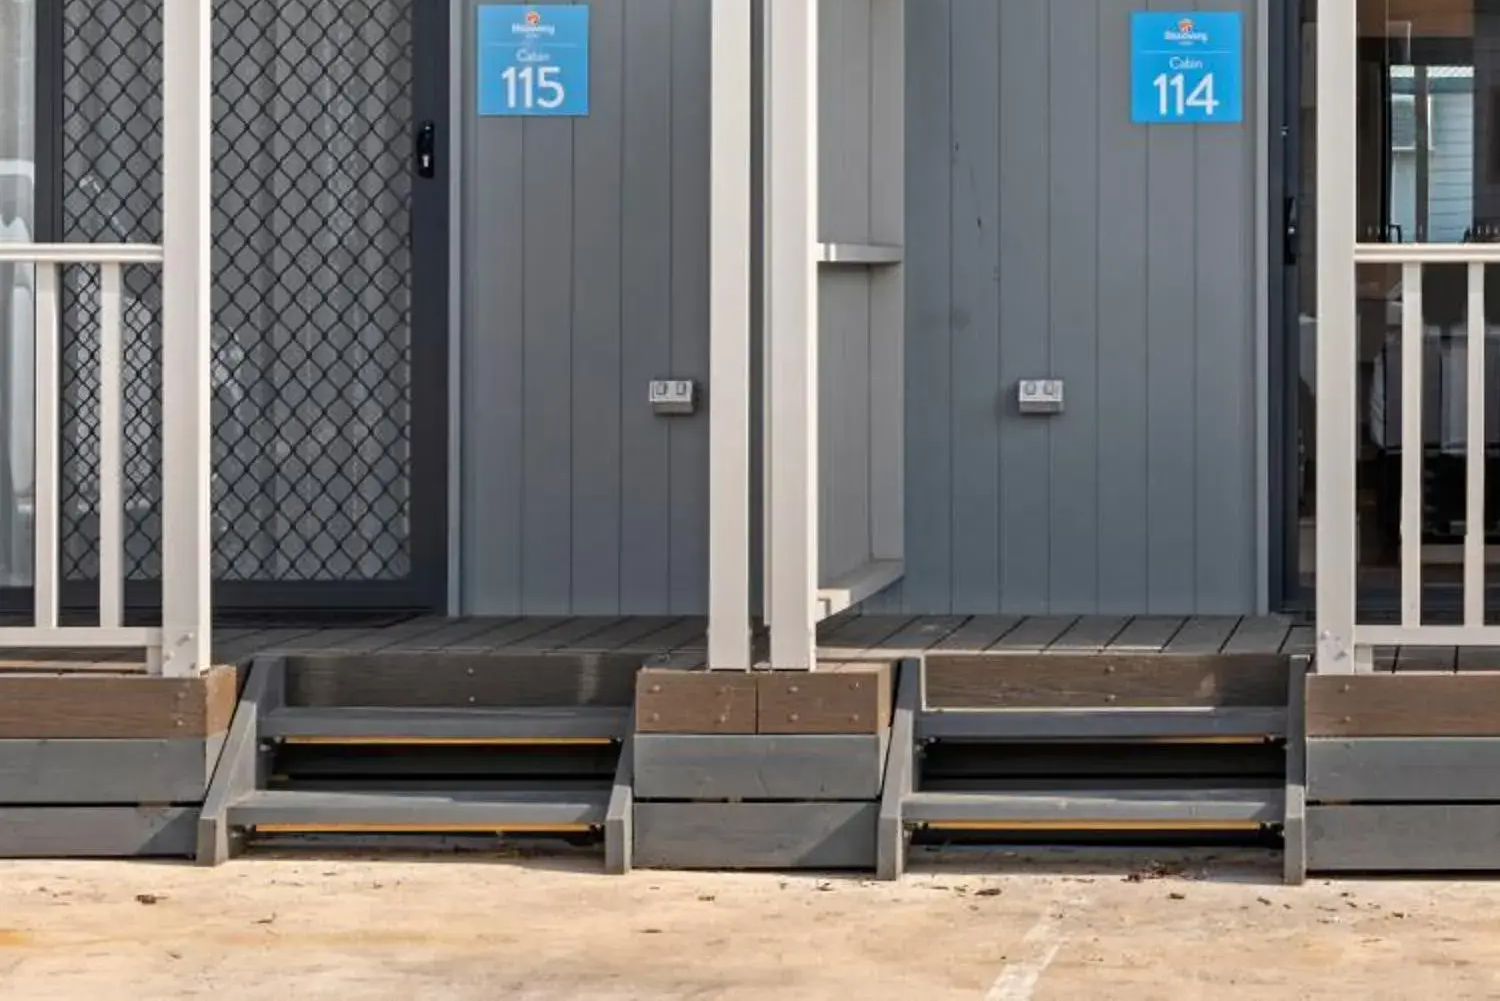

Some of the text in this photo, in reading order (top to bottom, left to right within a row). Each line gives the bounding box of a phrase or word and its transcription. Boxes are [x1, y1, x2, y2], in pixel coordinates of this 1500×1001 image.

[1168, 56, 1204, 70] Cabin
[501, 66, 565, 108] 115
[1153, 73, 1220, 116] 114
